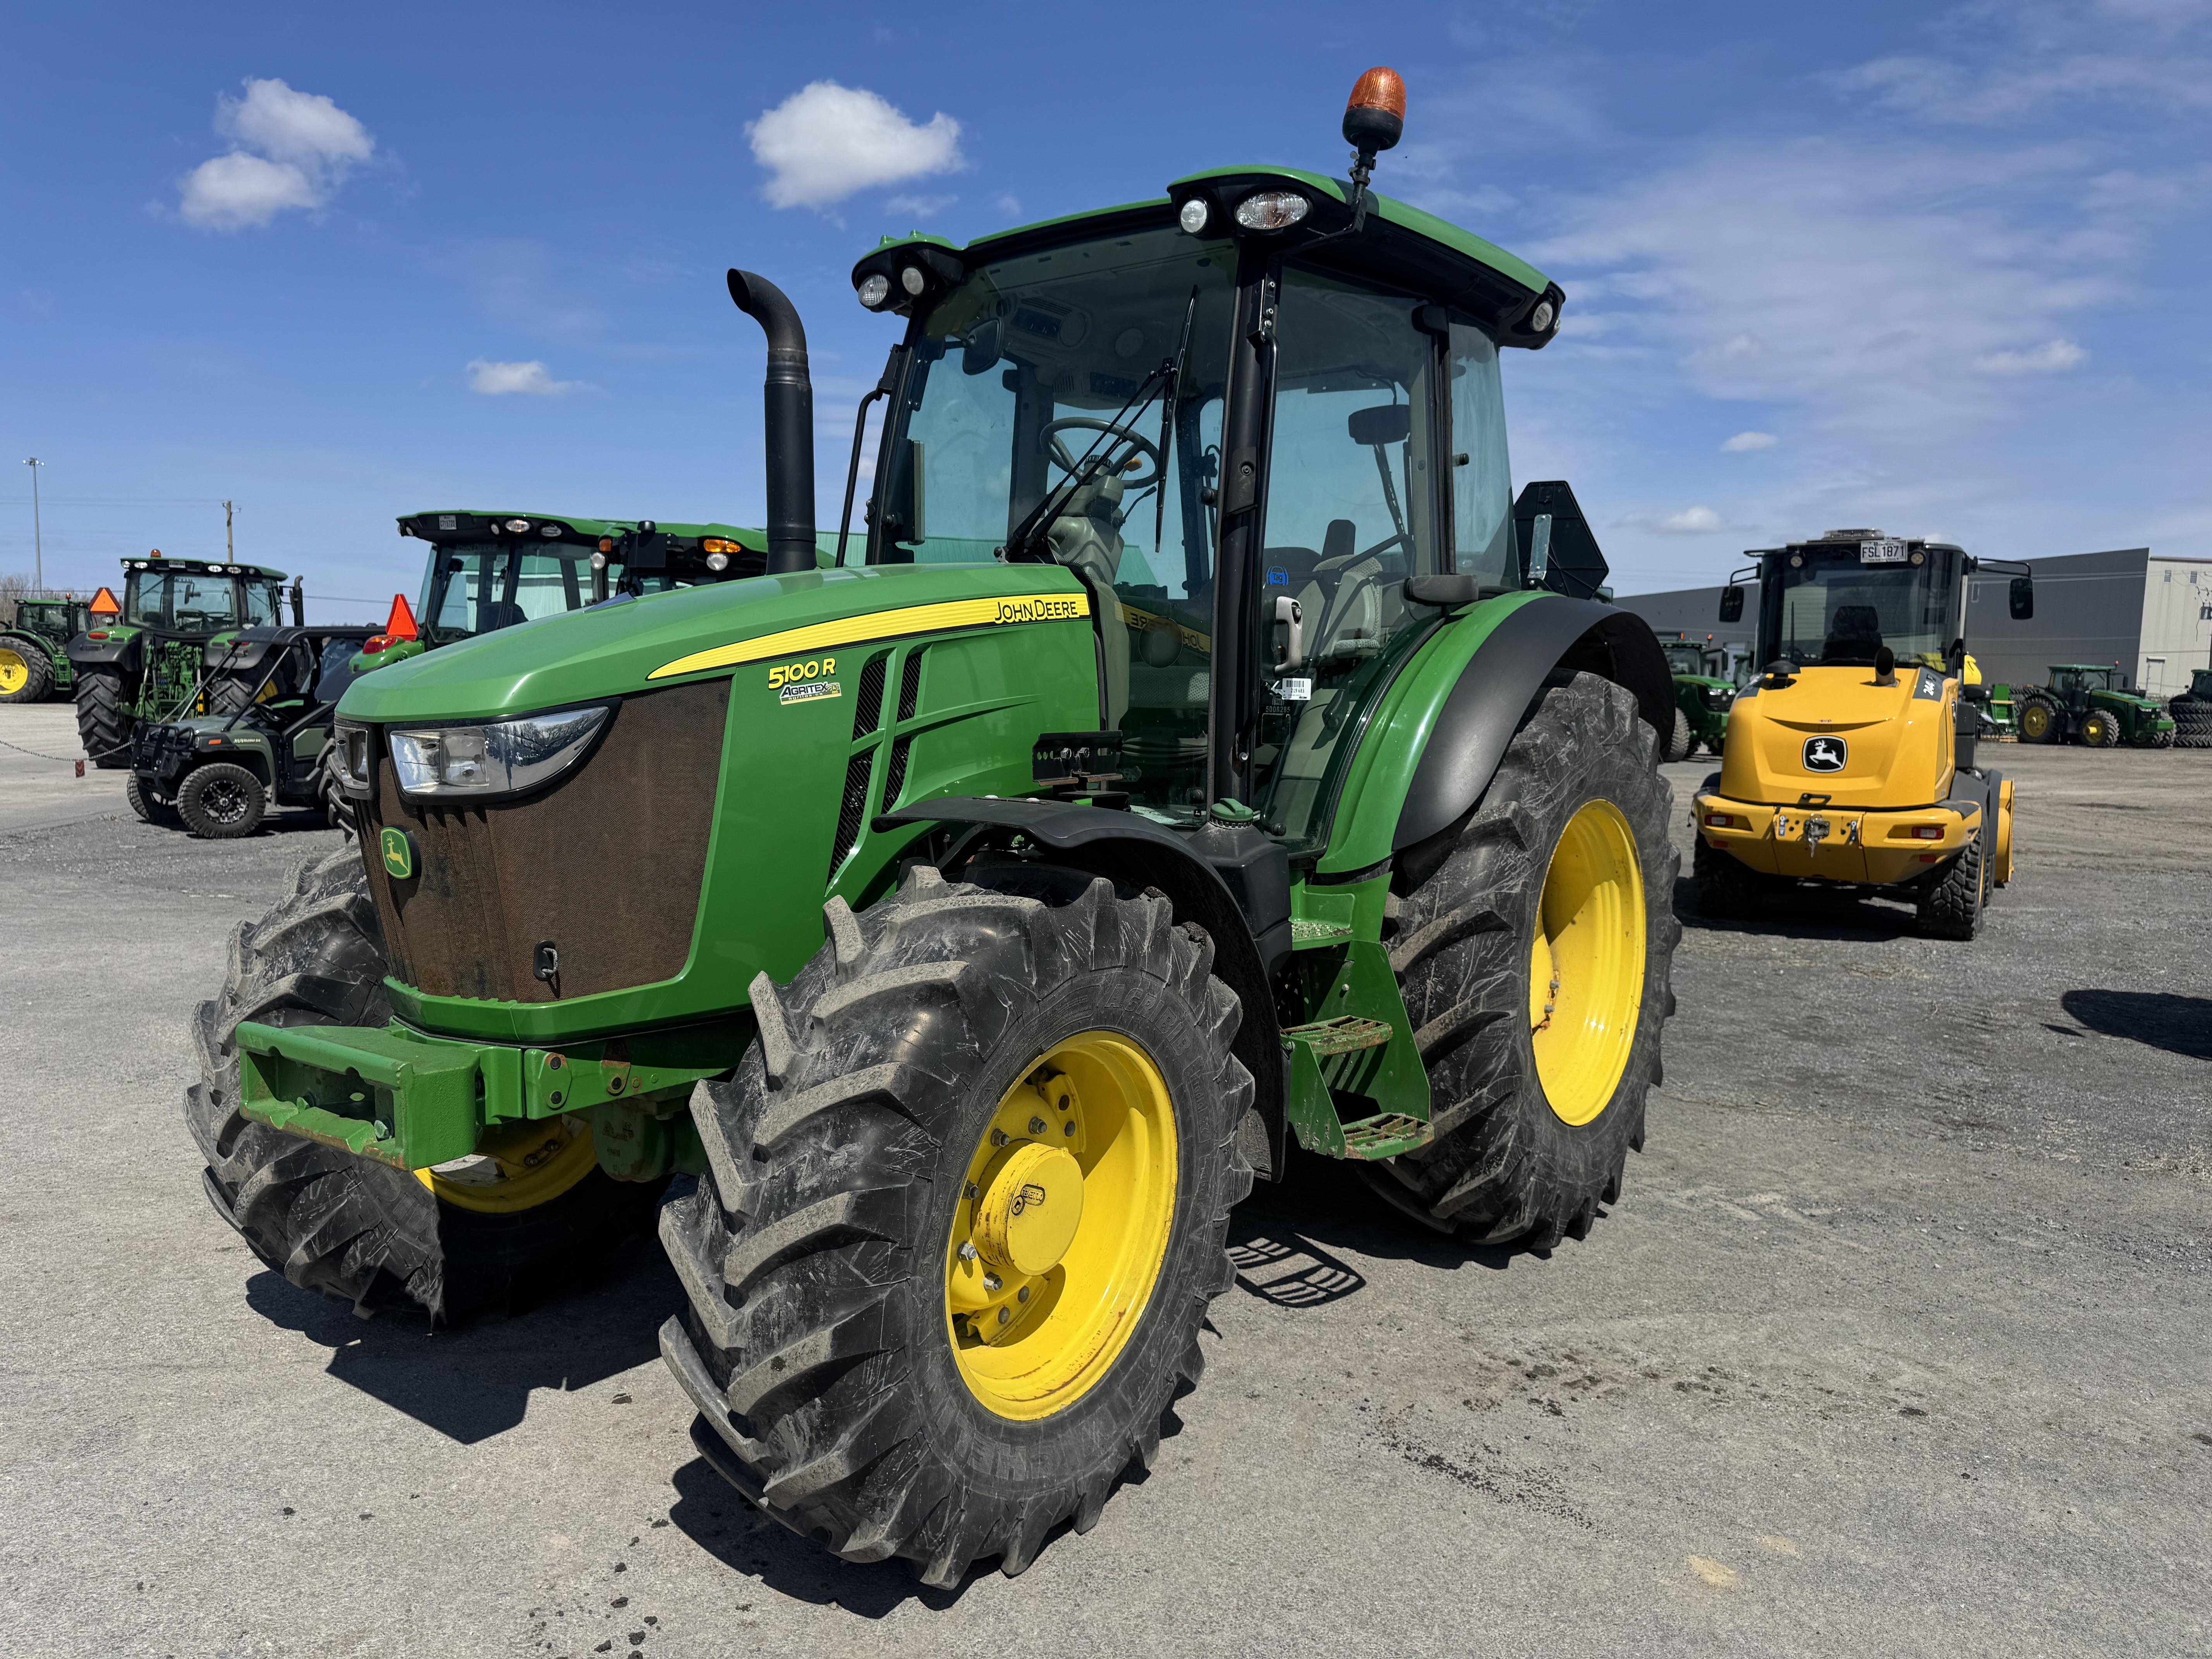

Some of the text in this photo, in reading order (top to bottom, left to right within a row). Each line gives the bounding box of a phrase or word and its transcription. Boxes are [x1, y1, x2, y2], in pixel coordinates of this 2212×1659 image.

[1862, 546, 1904, 558] FSL1871
[1273, 573, 1283, 582] Tag
[994, 599, 1078, 621] JOHN DEERE
[768, 658, 836, 690] 5100 R
[781, 683, 828, 697] AGRITEX
[1104, 984, 1192, 1056] AGRIBIB
